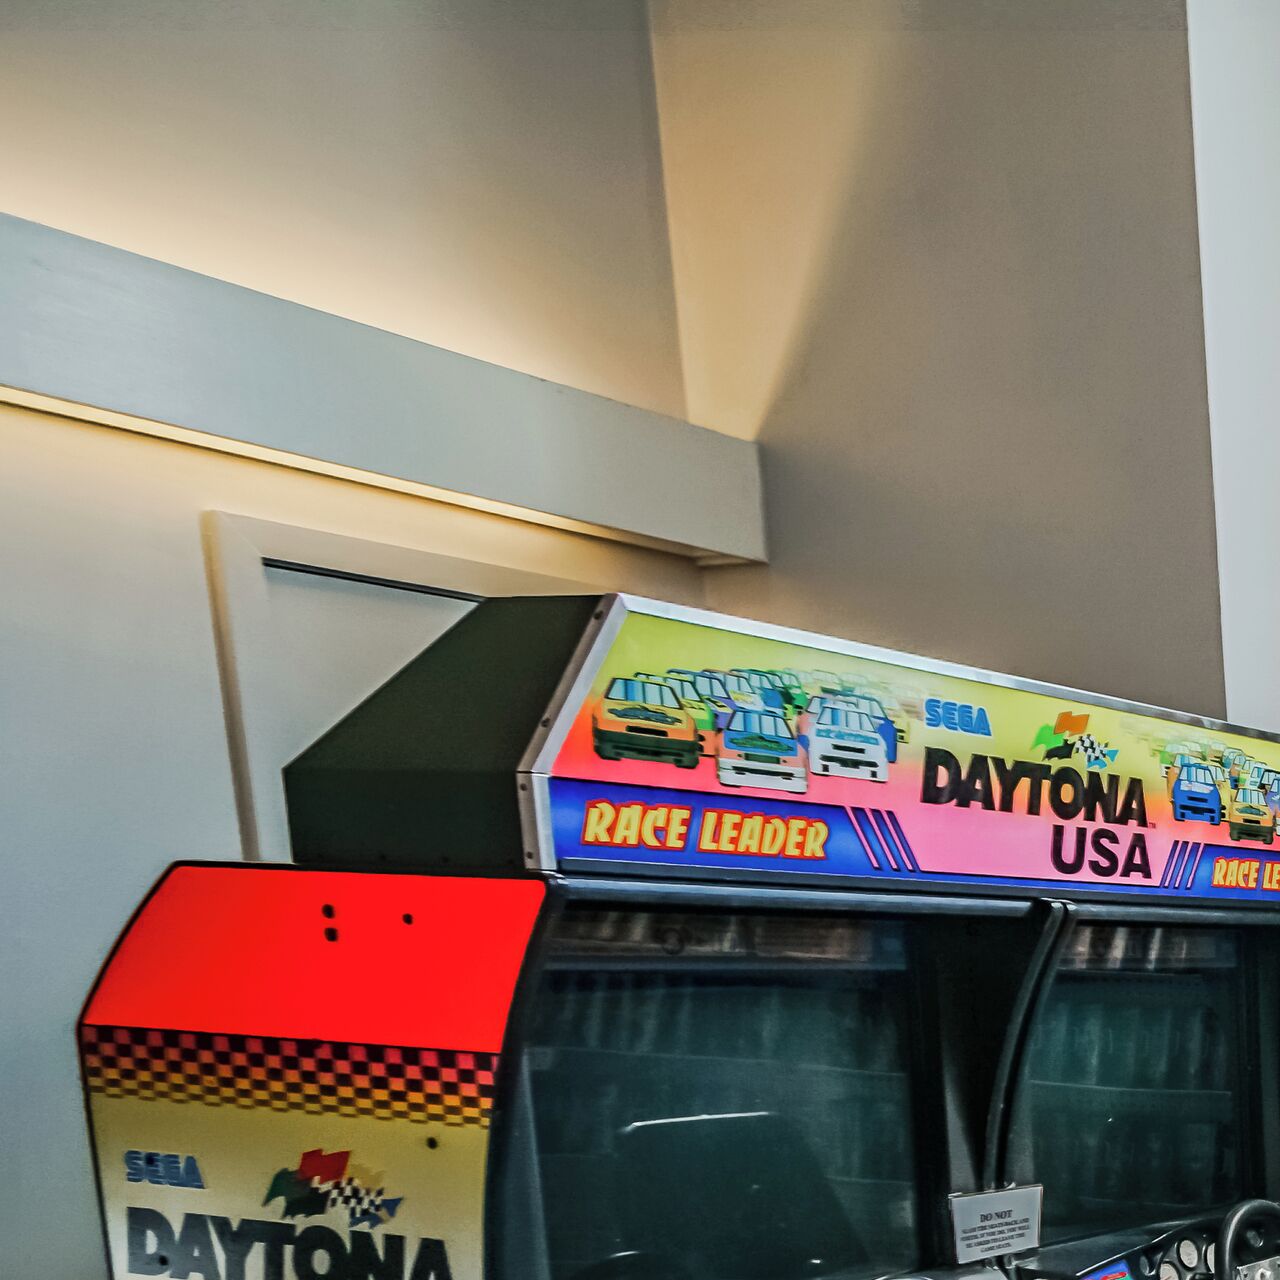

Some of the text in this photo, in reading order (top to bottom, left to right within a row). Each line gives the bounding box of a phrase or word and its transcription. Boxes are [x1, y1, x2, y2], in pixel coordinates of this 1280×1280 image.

[925, 698, 992, 736] SEGA
[921, 747, 1148, 829] DAYTONA
[582, 801, 828, 860] RACE LEADER
[1050, 824, 1153, 878] USA
[1212, 856, 1260, 890] RACE
[124, 1149, 205, 1189] SEGA
[980, 1209, 1013, 1222] DO NOT
